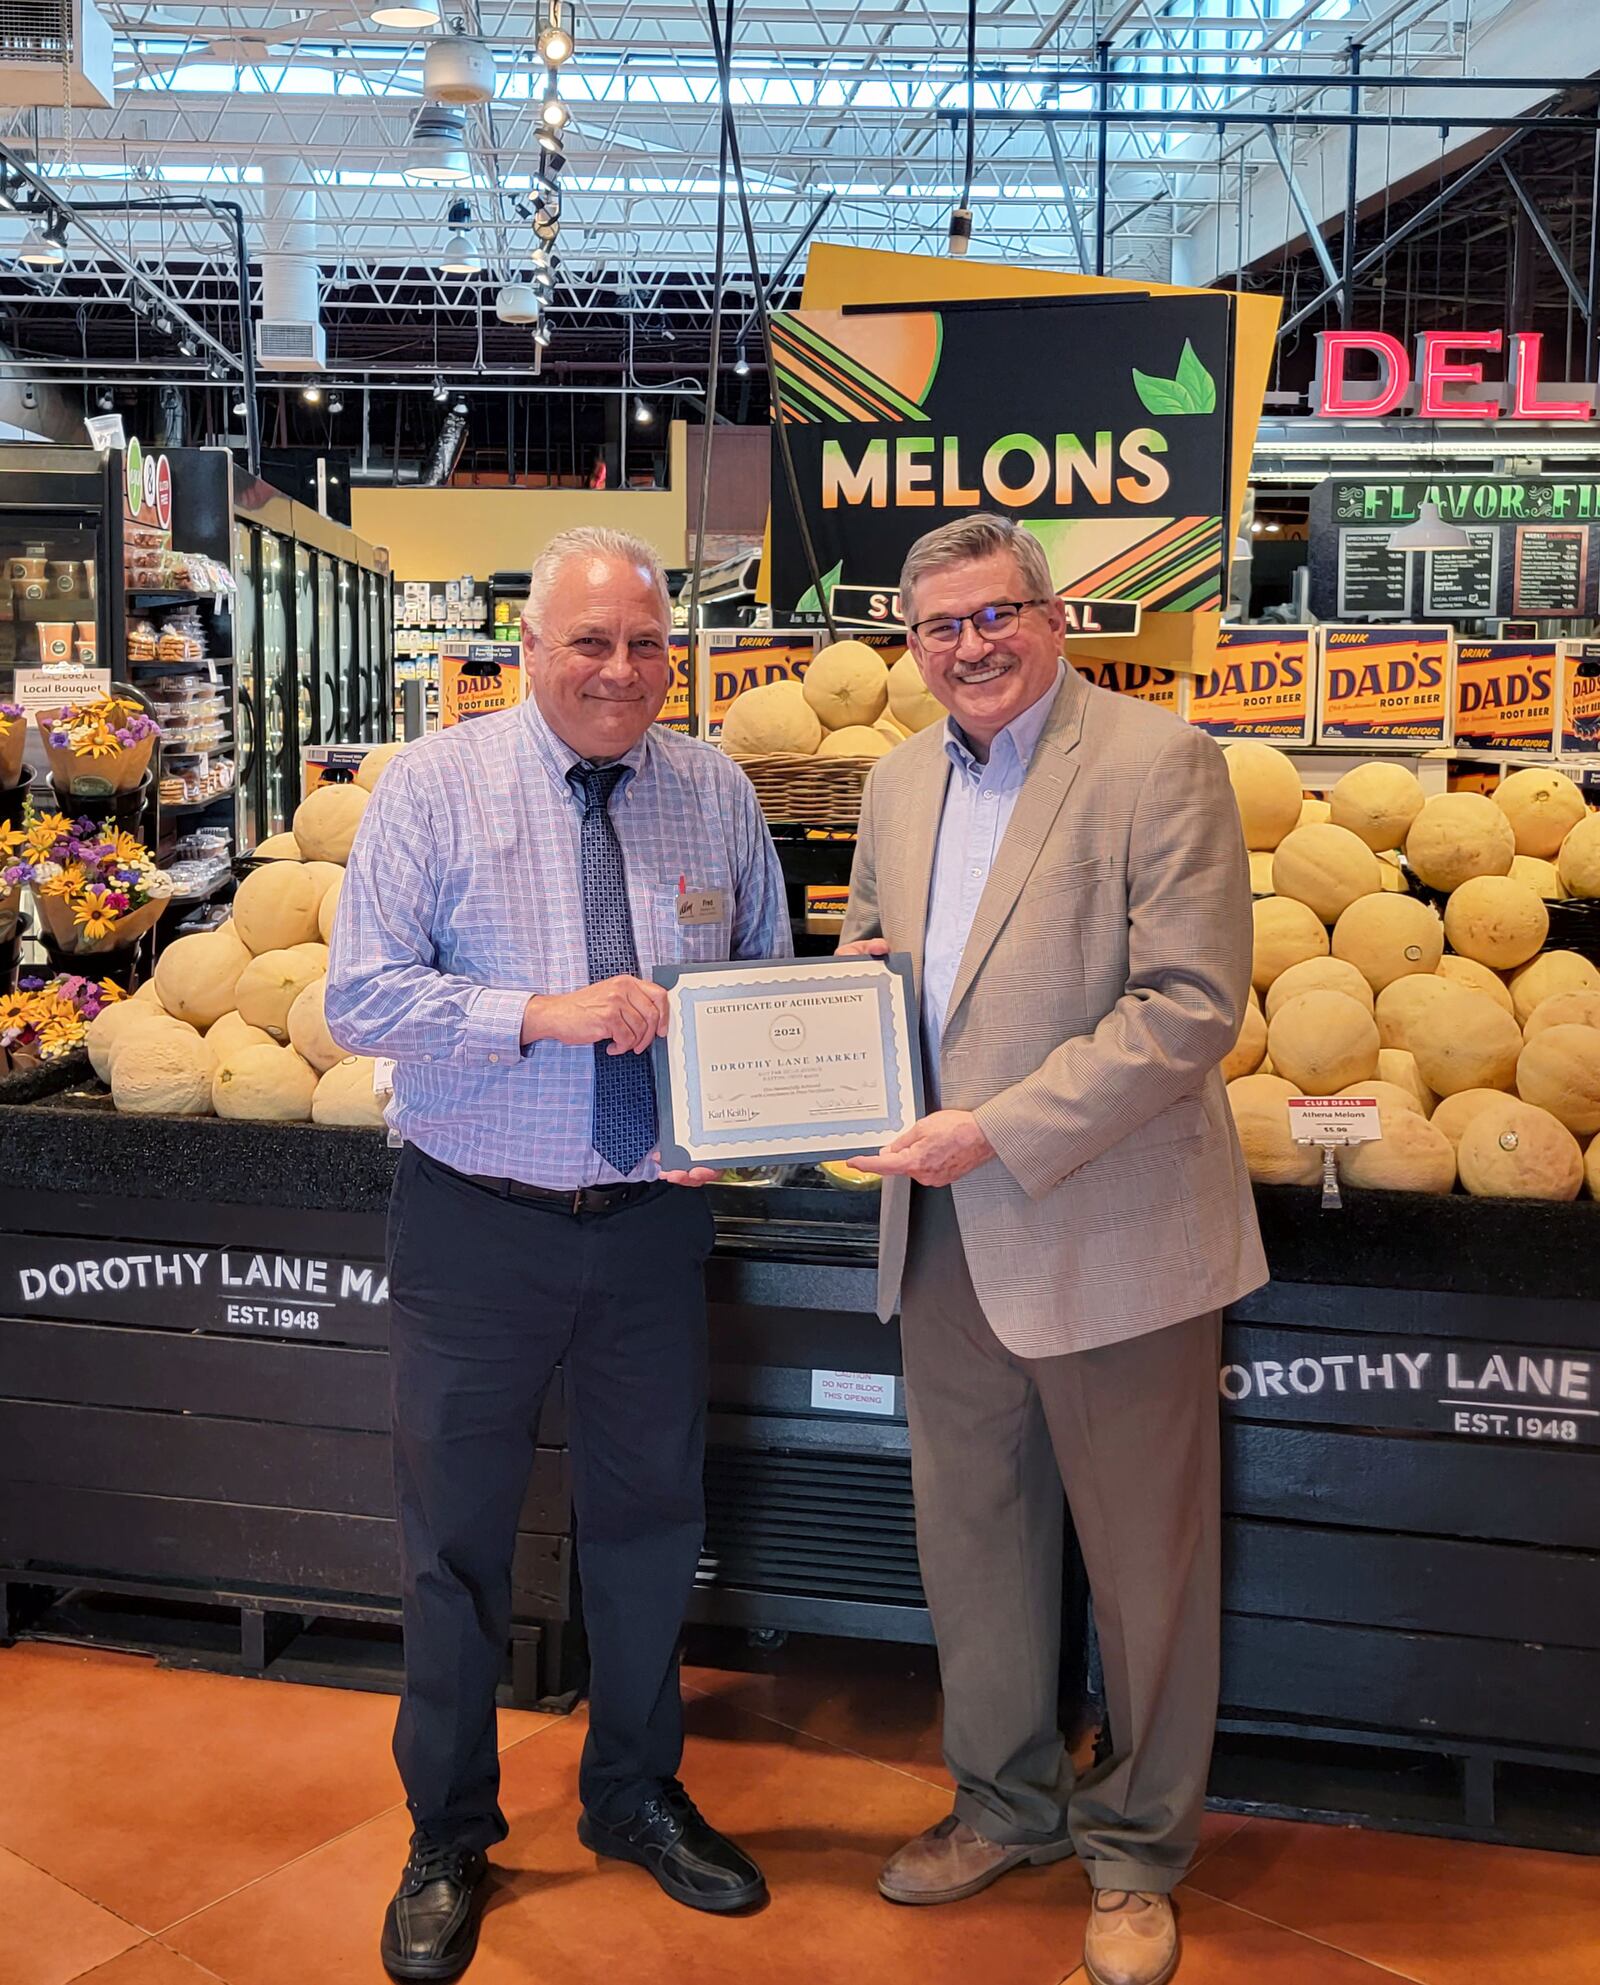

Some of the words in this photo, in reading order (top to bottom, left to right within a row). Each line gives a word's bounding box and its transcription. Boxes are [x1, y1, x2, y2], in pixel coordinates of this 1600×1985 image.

[822, 428, 1170, 509] MELONS
[1364, 484, 1530, 519] FLAVOR
[739, 635, 773, 647] DRINK
[1329, 633, 1369, 644] DRINK
[1460, 648, 1492, 658] DRINK
[1193, 651, 1304, 701] DAD'S
[1327, 652, 1443, 701] DAD'S
[23, 684, 51, 693] Local
[54, 684, 101, 694] Bouquet
[1458, 665, 1552, 713] DAD'S
[1149, 691, 1174, 702] BEER
[1243, 696, 1272, 707] ROOT
[1276, 693, 1302, 704] BEER
[1380, 696, 1410, 708] ROOT
[1413, 694, 1440, 705] BEER
[458, 700, 481, 711] ROOT
[485, 698, 505, 708] BEER
[1573, 704, 1590, 715] ROOT
[1500, 709, 1525, 720] ROOT
[1527, 707, 1550, 718] BEER
[1254, 725, 1302, 734] DELICIOUS
[1390, 726, 1440, 736] DELICIOUS
[1509, 738, 1550, 748] DELICIOUS
[706, 1002, 772, 1015] CERTIFICATE
[774, 1000, 788, 1009] OF
[789, 994, 864, 1008] ACHIEVEMENT
[773, 1027, 801, 1037] 2021
[711, 1060, 772, 1072] DOROTHY
[777, 1056, 810, 1067] LANE
[815, 1052, 868, 1064] MARKET
[19, 1253, 209, 1300] DOROTHY
[221, 1253, 328, 1294] LANE
[227, 1305, 270, 1327] EST.
[274, 1308, 320, 1330] 1948
[1219, 1353, 1430, 1400] OROTHY
[1447, 1353, 1591, 1400] LANE
[822, 1380, 835, 1388] DO
[836, 1382, 854, 1390] NOT
[855, 1384, 884, 1393] BLOCK
[823, 1391, 842, 1400] THIS
[843, 1394, 882, 1404] OPENING
[1454, 1412, 1510, 1437] EST.
[1516, 1415, 1577, 1441] 1948
